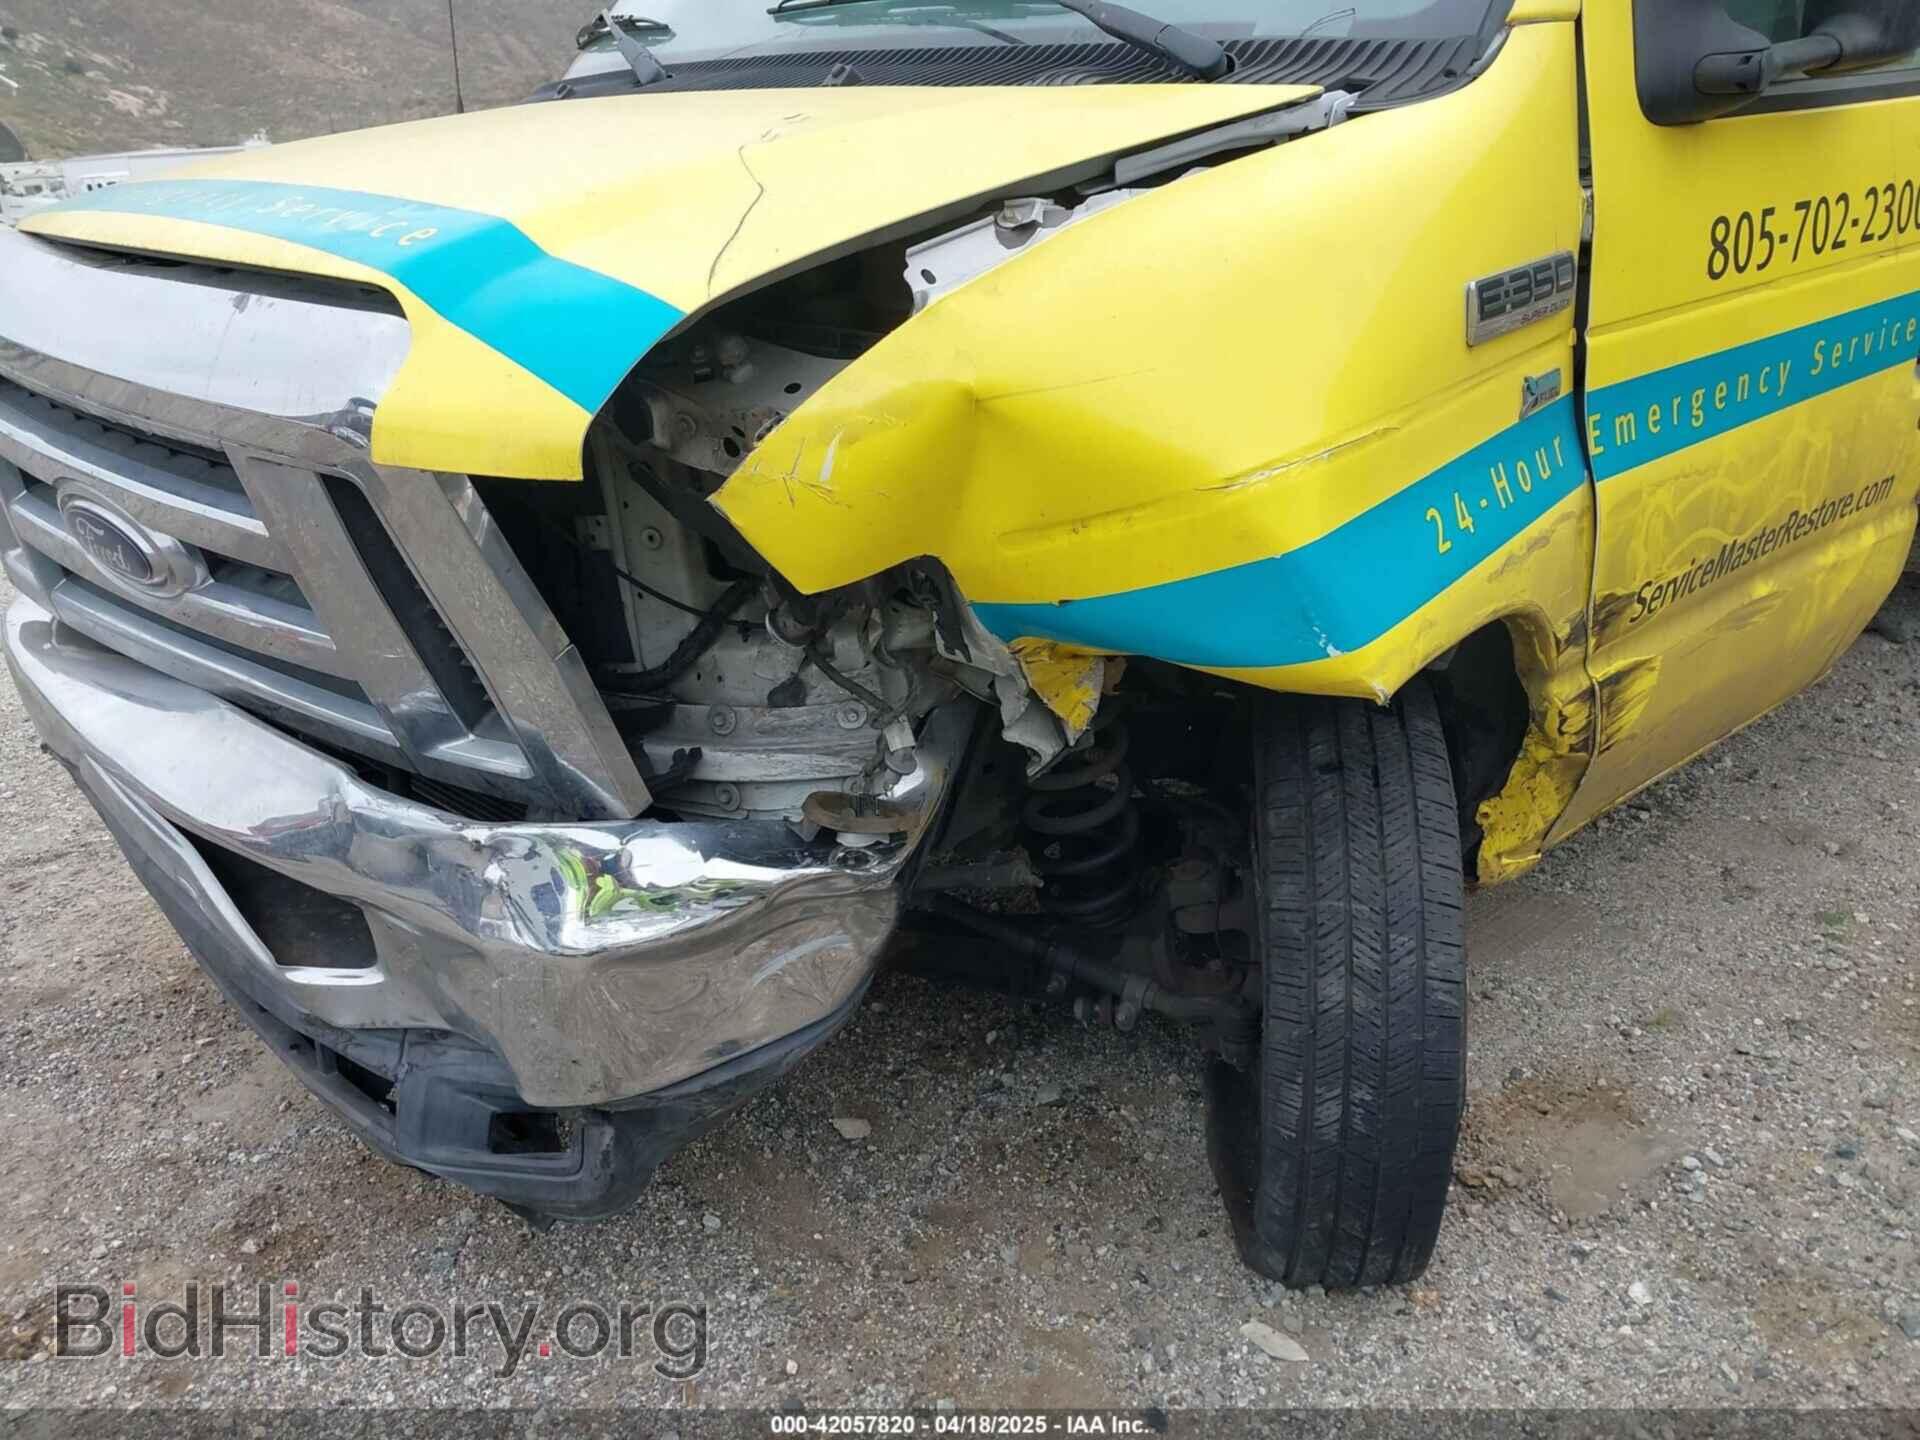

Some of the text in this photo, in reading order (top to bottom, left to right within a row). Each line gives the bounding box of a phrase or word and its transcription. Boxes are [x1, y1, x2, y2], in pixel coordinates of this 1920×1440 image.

[257, 196, 438, 246] Service
[1426, 316, 1917, 556] 24-Hour Emergency Service
[1629, 475, 1895, 623] ServiceMasterRestore.com
